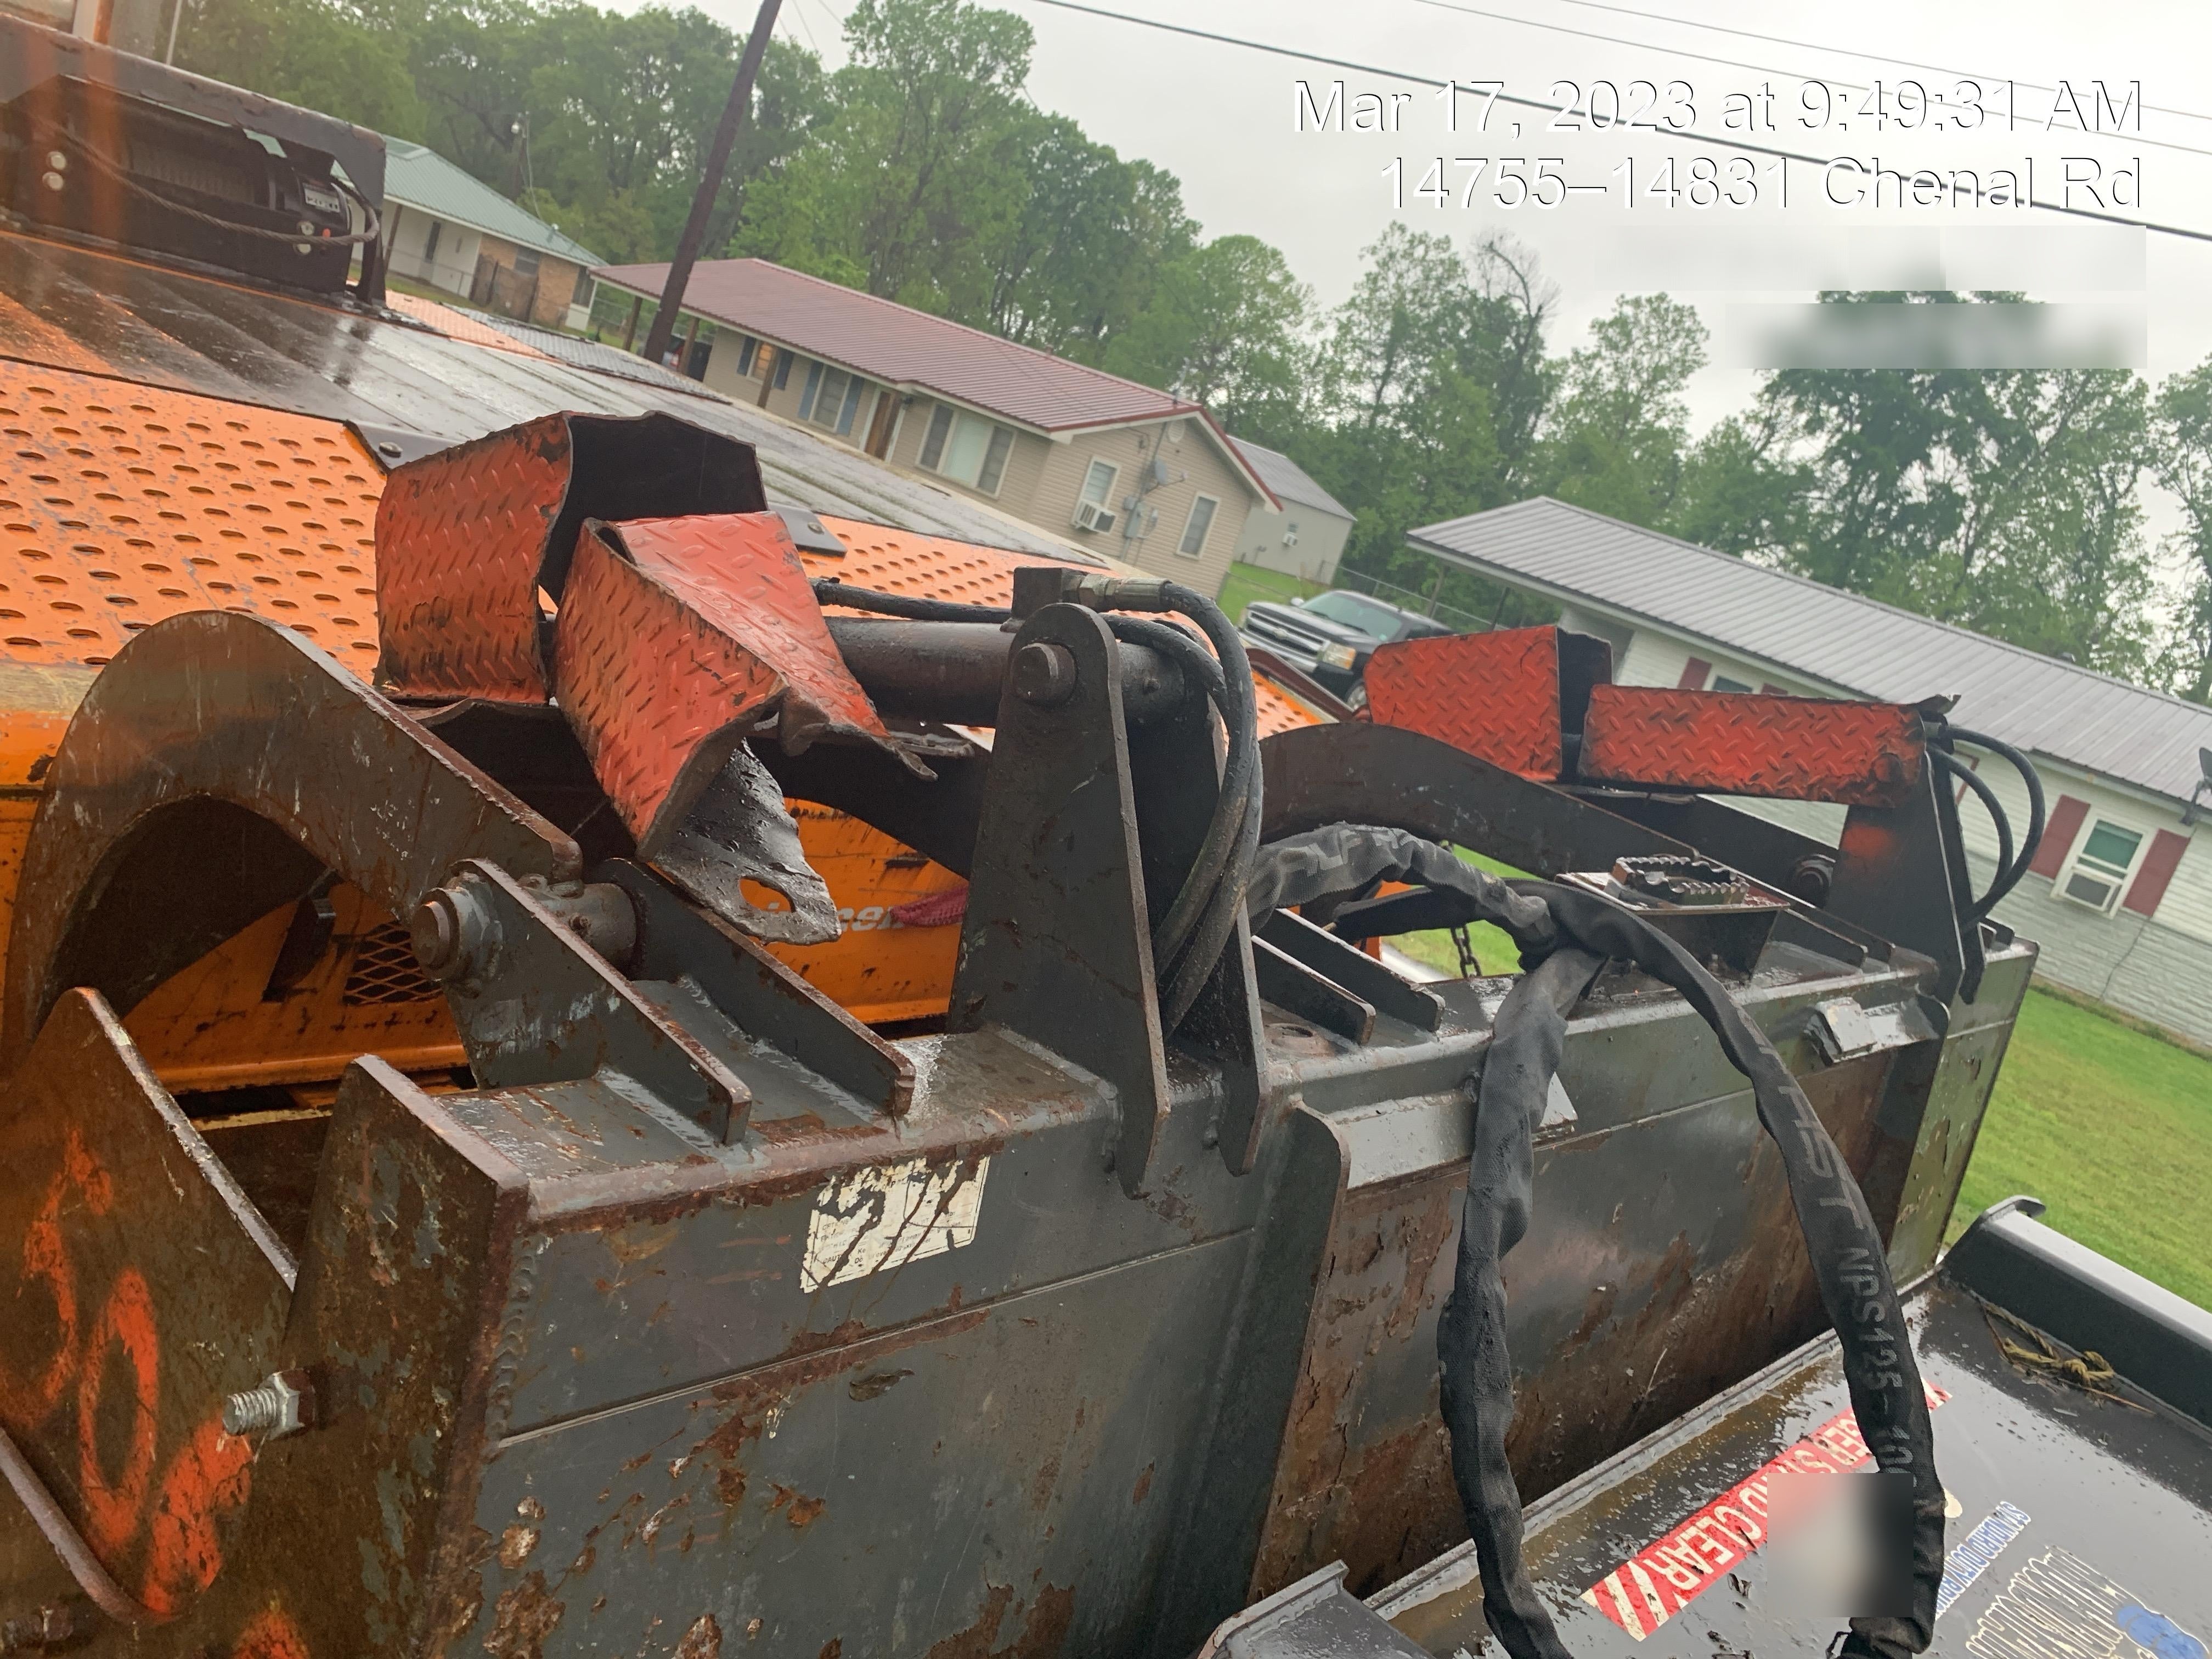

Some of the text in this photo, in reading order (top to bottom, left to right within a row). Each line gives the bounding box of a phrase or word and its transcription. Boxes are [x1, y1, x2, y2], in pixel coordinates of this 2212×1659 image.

[1643, 1505, 1763, 1591] CLEAR
[1966, 1501, 2032, 1559] STANDARD
[1944, 1543, 1990, 1587] DUTY
